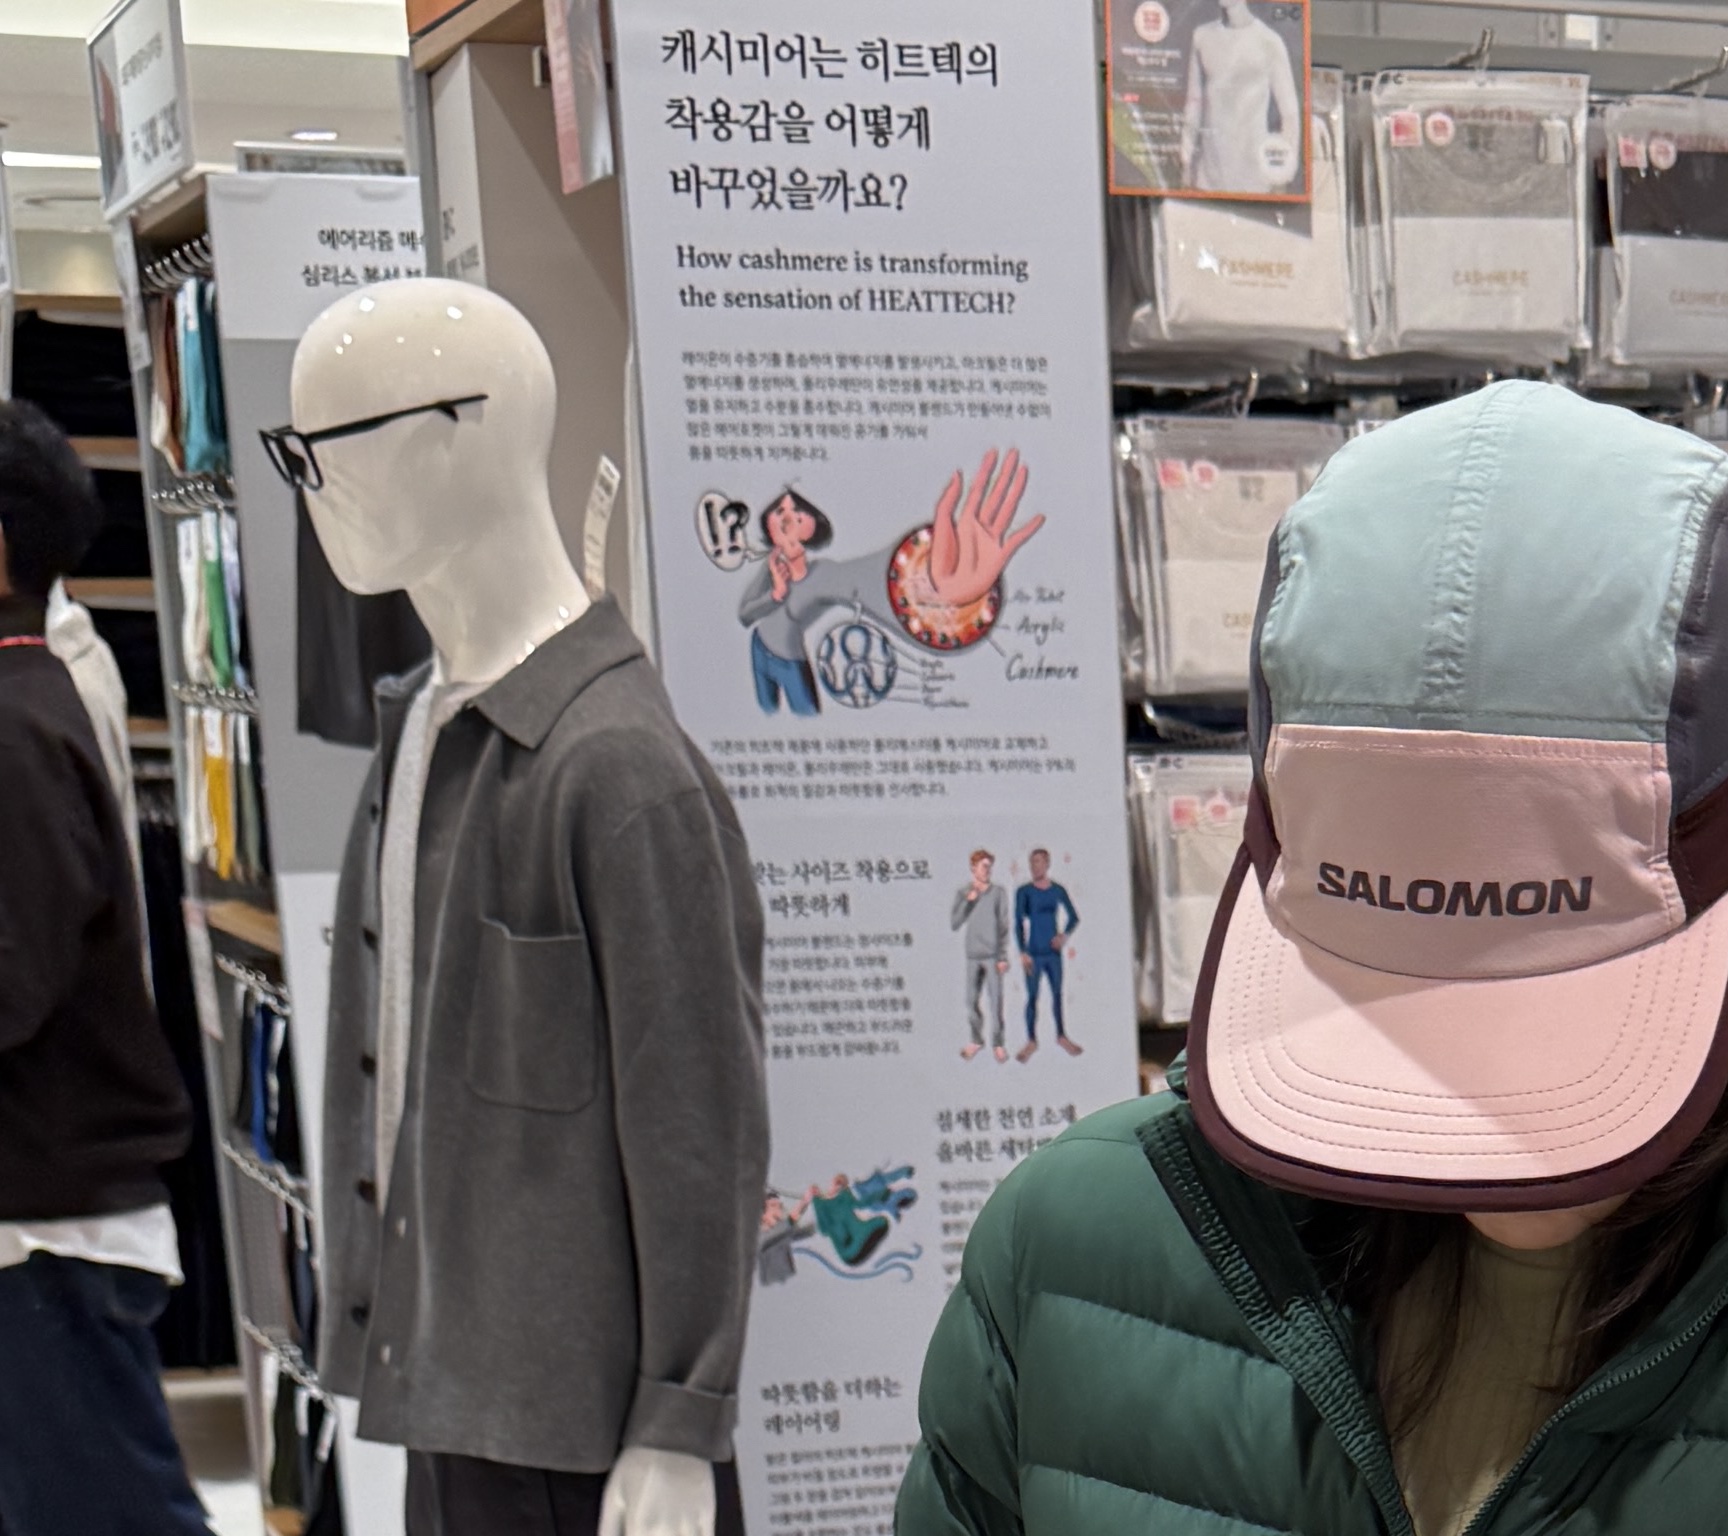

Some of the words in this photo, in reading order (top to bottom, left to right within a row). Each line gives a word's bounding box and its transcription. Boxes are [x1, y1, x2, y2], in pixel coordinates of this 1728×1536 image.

[661, 29, 847, 79] 캐시미어는
[856, 38, 998, 87] 히트텍의
[665, 97, 814, 145] 착용감을
[824, 103, 931, 150] 어떻게
[669, 164, 908, 213] 바꾸었을까요?
[317, 228, 394, 251] 에어리즘
[302, 265, 358, 287] 심리스
[676, 245, 732, 270] How
[738, 248, 847, 274] cashmere
[854, 251, 873, 274] is
[880, 252, 1029, 282] transforming
[679, 286, 716, 309] the
[723, 288, 832, 311] sensation
[839, 288, 863, 312] of
[869, 290, 1015, 316] HEATTECH?
[792, 860, 851, 885] 사이즈
[854, 859, 933, 883] 착용으로
[1317, 861, 1593, 918] SALOMON
